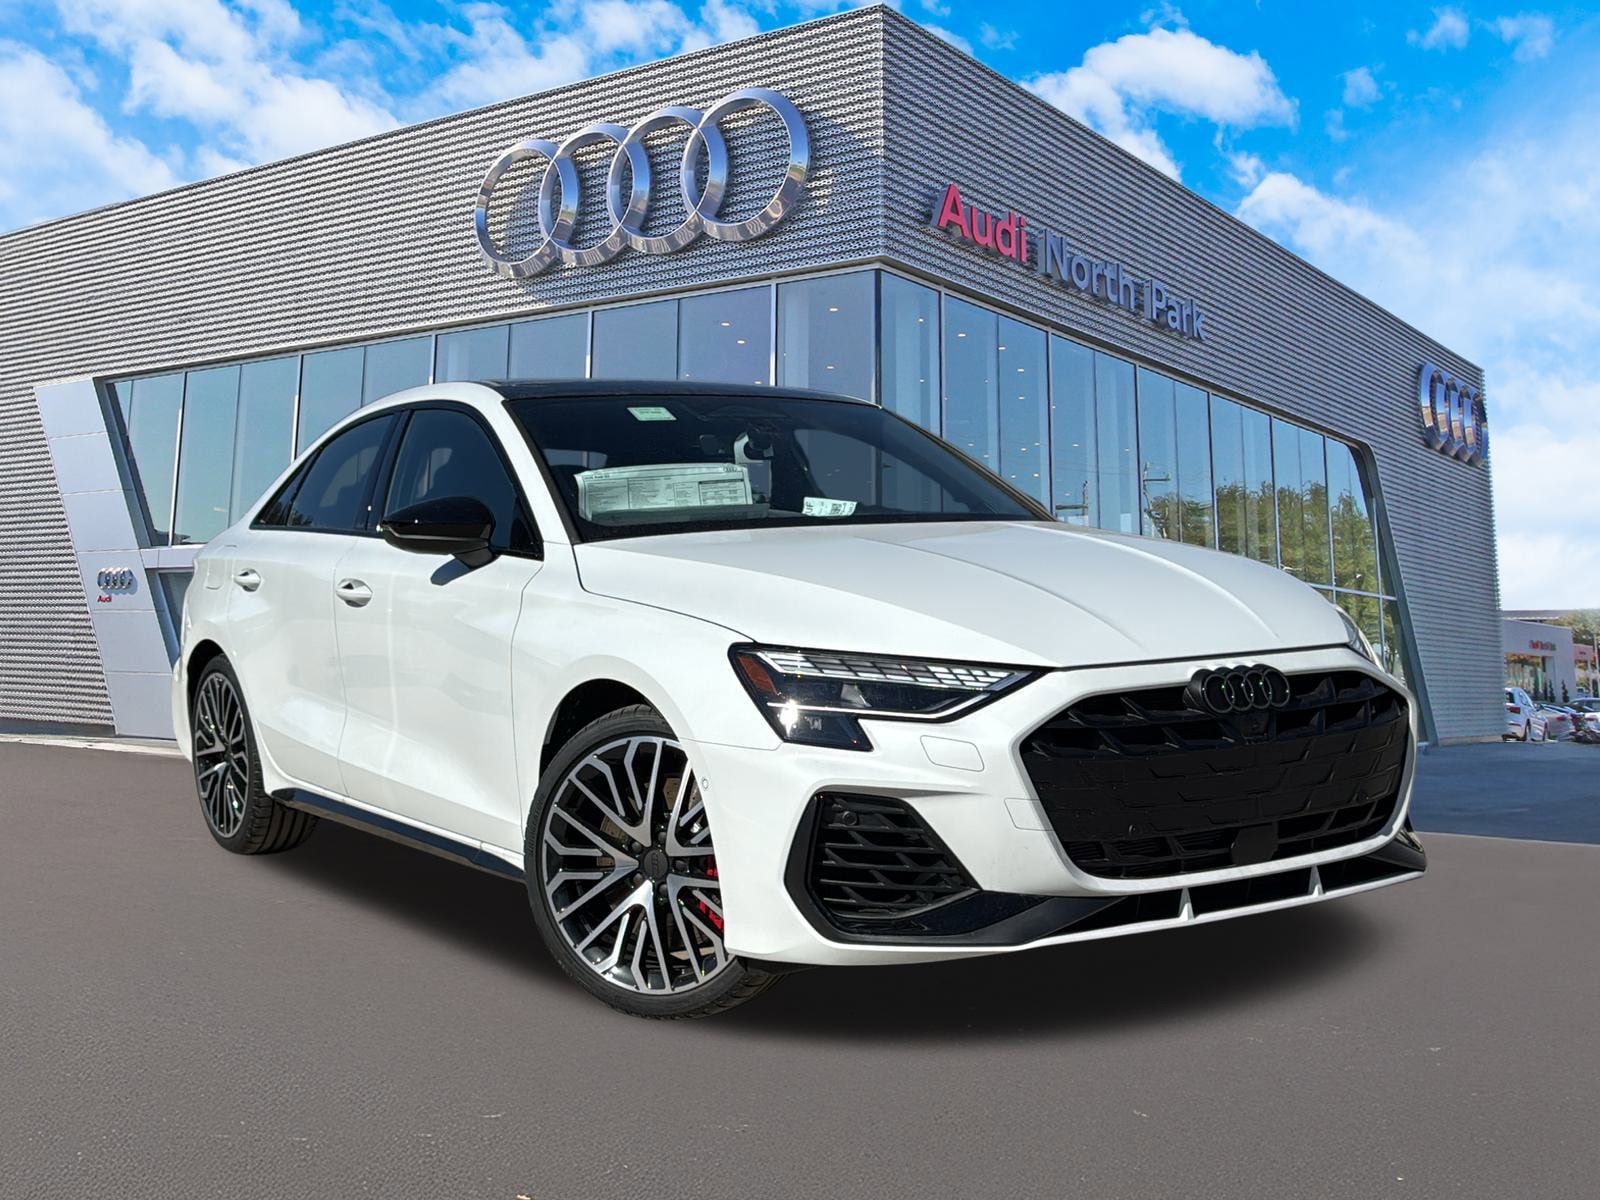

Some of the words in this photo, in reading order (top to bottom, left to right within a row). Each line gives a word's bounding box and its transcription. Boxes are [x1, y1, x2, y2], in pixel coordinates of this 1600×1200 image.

[933, 184, 1028, 263] Audi
[1038, 229, 1136, 312] North
[1144, 279, 1206, 341] Park
